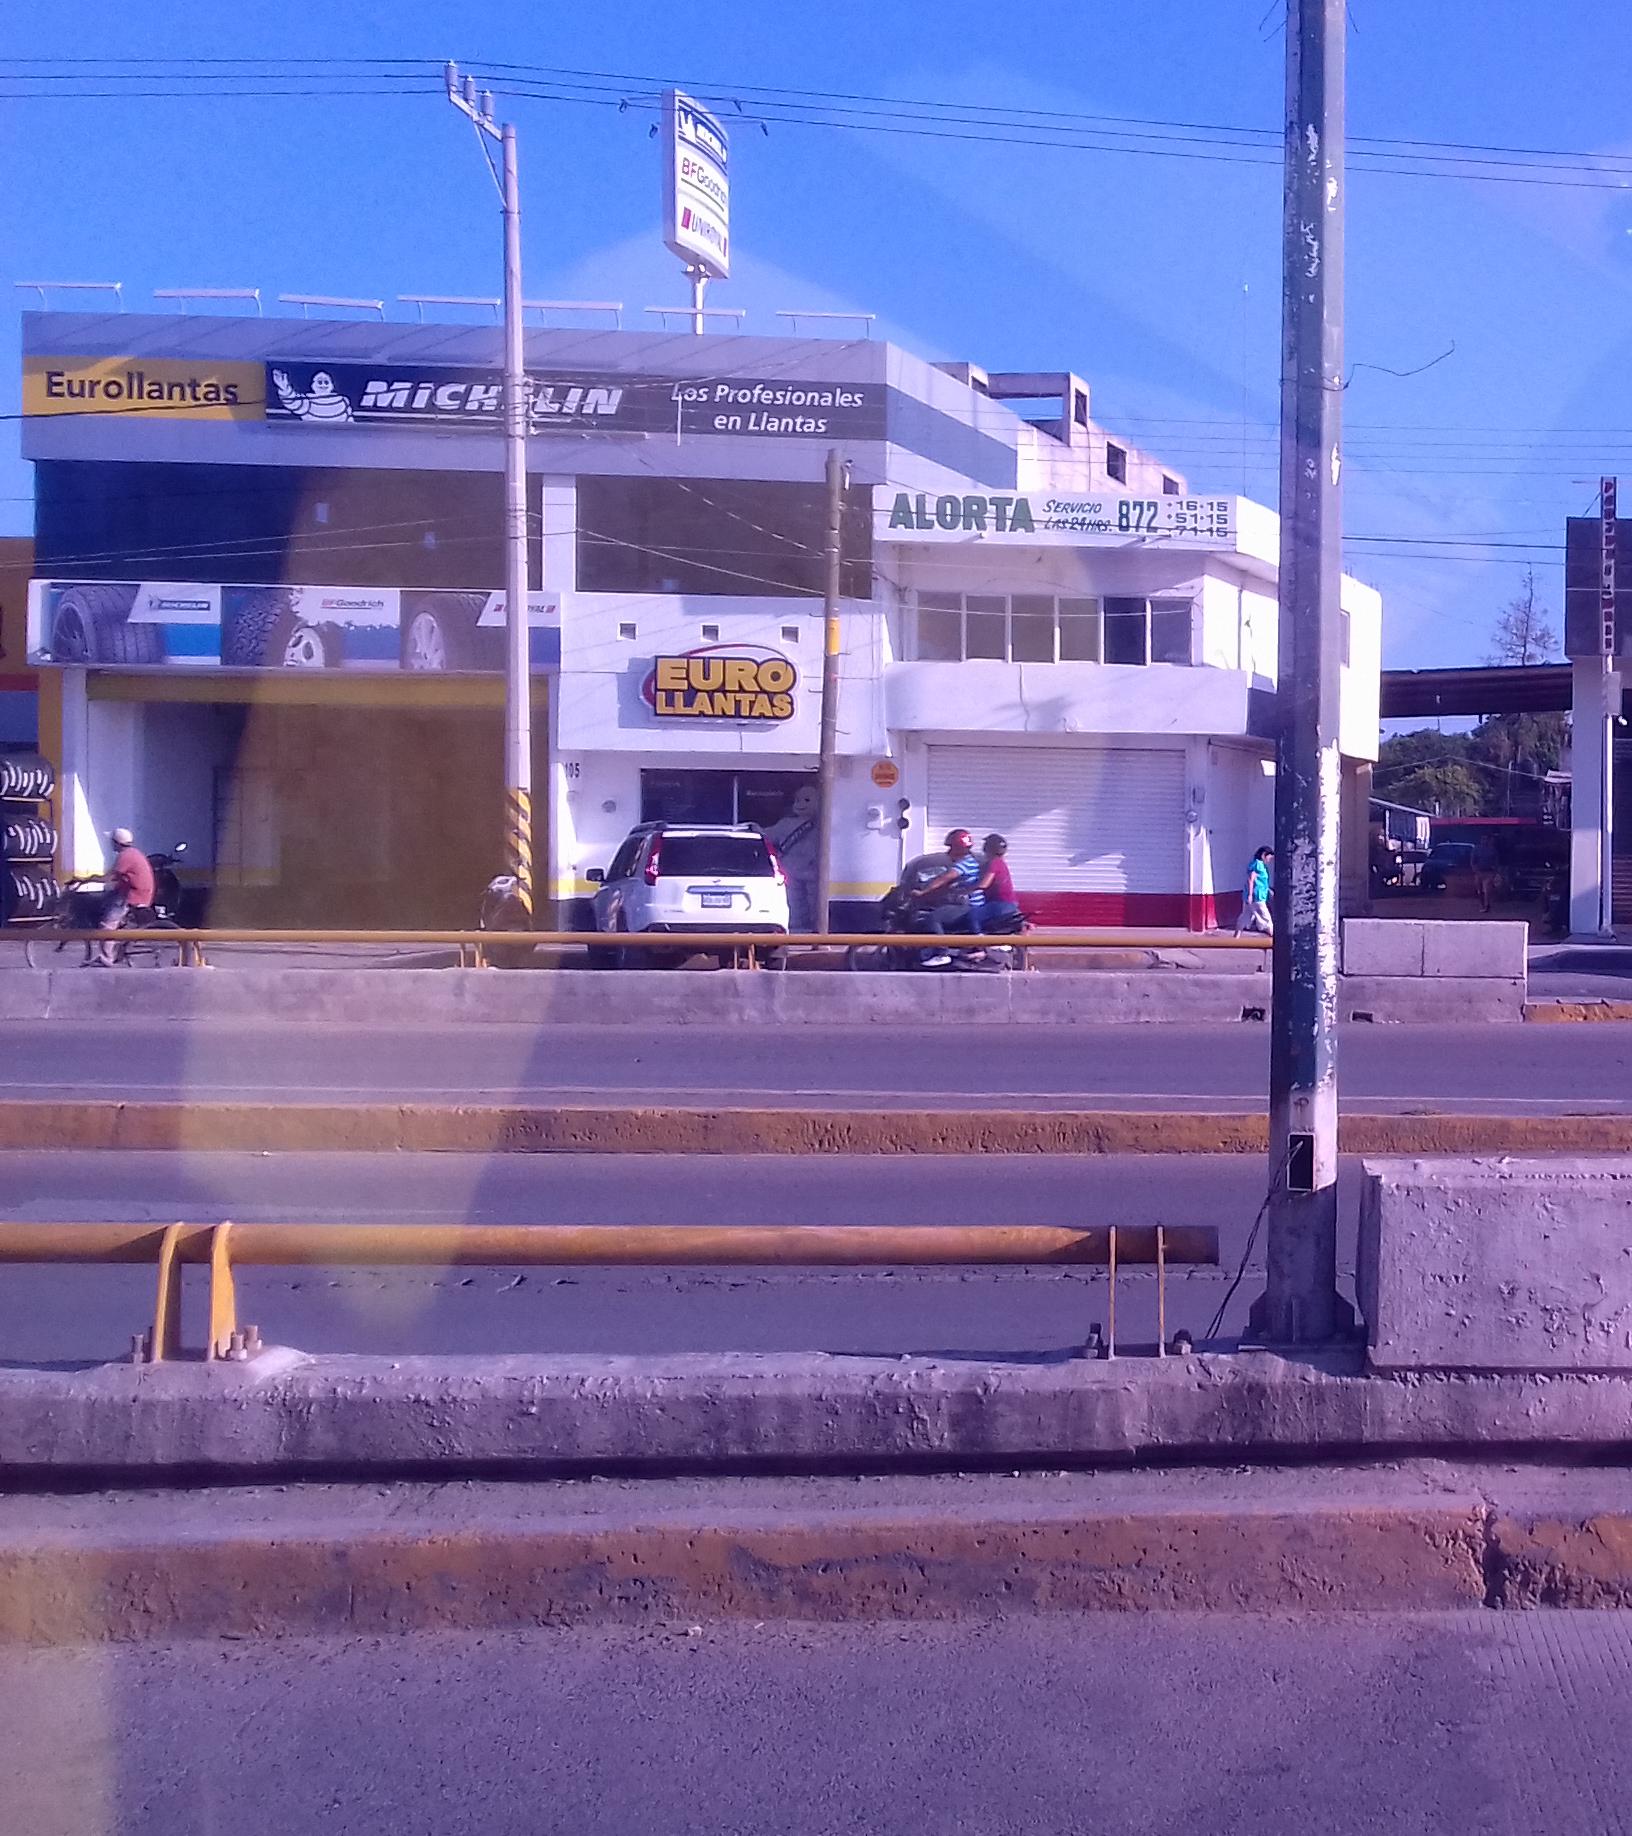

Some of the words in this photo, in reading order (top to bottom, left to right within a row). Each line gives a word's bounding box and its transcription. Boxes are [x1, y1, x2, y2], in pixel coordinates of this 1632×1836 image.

[45, 371, 238, 405] Eurollantas
[359, 380, 623, 415] MICHLIN
[671, 385, 710, 402] Los
[714, 383, 865, 408] Profesionales
[713, 414, 742, 430] en
[747, 411, 828, 433] Llantas
[888, 492, 1036, 533] ALORTA
[1118, 500, 1159, 533] 872
[1042, 499, 1102, 514] SERVICIO
[656, 658, 795, 693] EURO
[656, 692, 794, 717] LLANTAS
